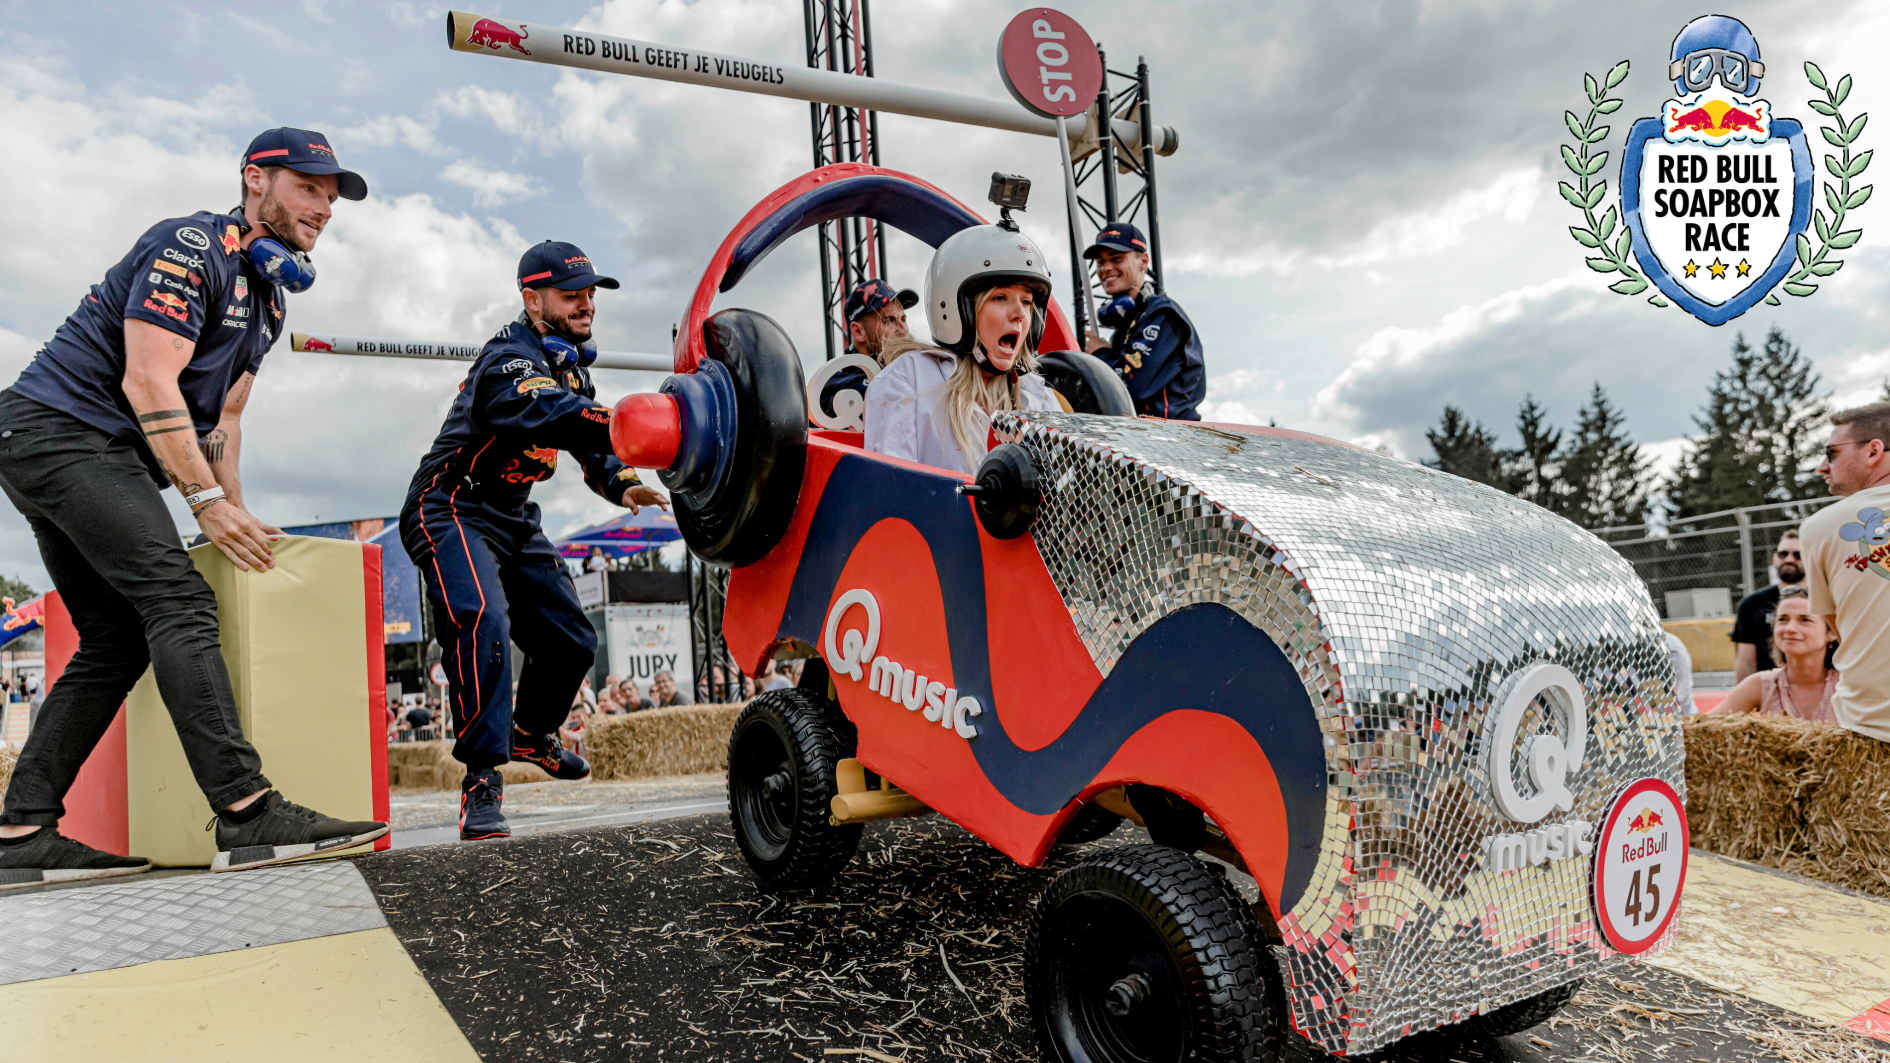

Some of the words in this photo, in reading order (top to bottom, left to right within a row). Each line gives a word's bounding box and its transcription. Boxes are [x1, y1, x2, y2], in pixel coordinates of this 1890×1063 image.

[563, 34, 596, 56] RED
[602, 40, 640, 63] BULL
[645, 47, 689, 70] GEEFT
[694, 55, 709, 74] JE
[714, 58, 784, 85] VLEUGELS
[1032, 19, 1076, 102] STOP
[163, 248, 199, 268] Claro
[164, 278, 183, 290] Cash
[184, 286, 199, 297] App
[143, 299, 167, 314] Red
[166, 306, 189, 322] Bull
[357, 342, 376, 353] RED
[380, 343, 402, 354] BULL
[405, 344, 433, 355] GEEFT
[436, 345, 445, 356] JE
[448, 346, 481, 357] VLEUG
[580, 407, 597, 421] Red
[595, 412, 610, 424] Bull
[627, 654, 678, 678] JURY
[1490, 664, 1587, 823] Q
[1484, 820, 1594, 874] music
[1622, 838, 1645, 863] Red
[1646, 831, 1668, 857] Bull
[1625, 863, 1661, 927] 45
